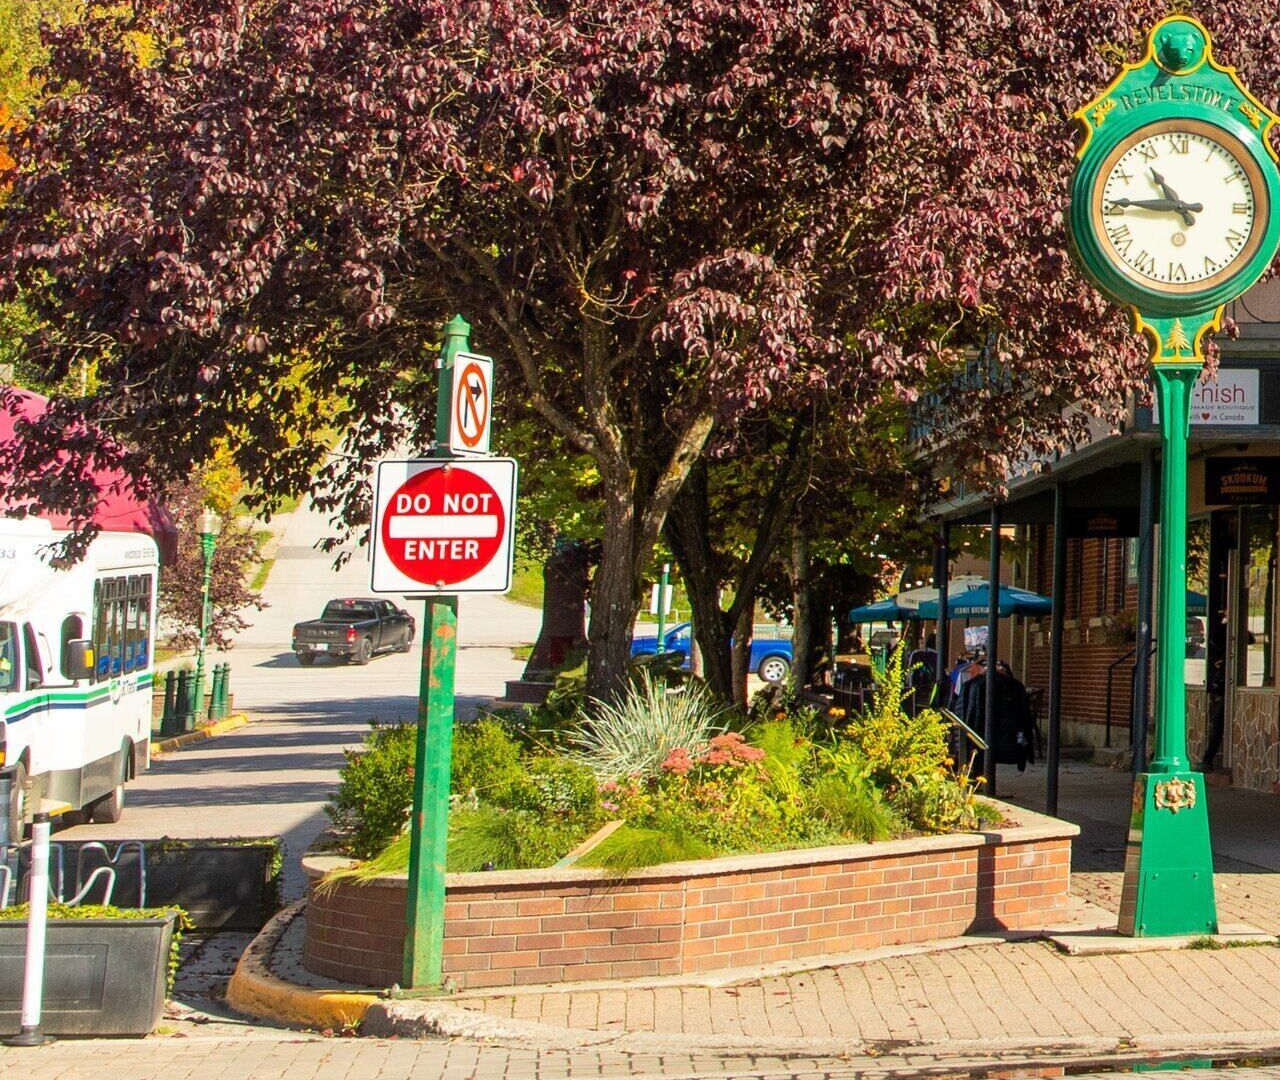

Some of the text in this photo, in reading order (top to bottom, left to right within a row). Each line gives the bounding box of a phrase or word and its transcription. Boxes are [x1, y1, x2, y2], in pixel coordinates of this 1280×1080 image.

[1119, 83, 1239, 114] REVELSTOKE
[1220, 412, 1245, 421] Canada
[1221, 472, 1268, 486] SKOOKUM
[396, 493, 493, 514] DO NOT
[404, 540, 479, 561] ENTER
